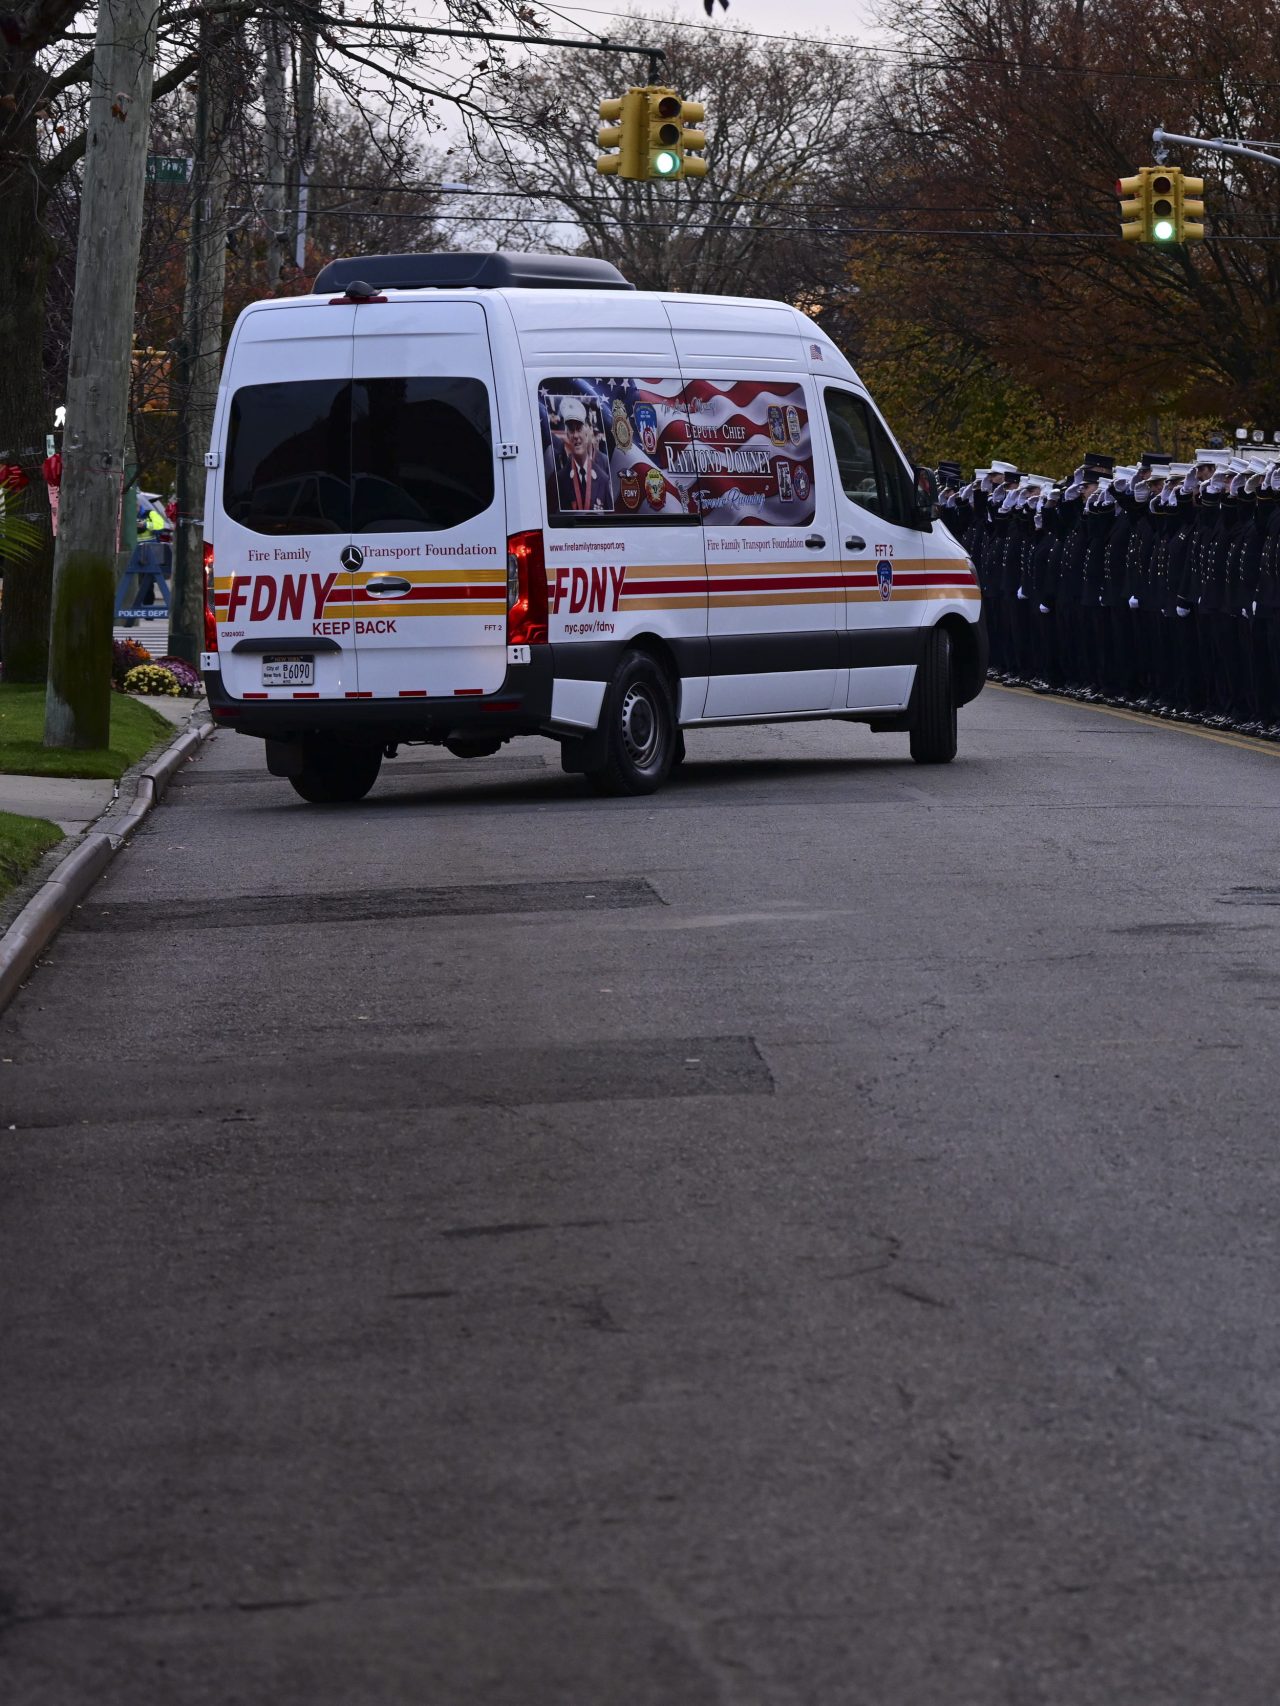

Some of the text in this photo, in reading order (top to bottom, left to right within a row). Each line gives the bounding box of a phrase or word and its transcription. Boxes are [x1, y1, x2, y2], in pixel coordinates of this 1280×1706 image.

[685, 424, 746, 439] DEPUTY CHIEF
[665, 446, 771, 473] RAYMOND DOWNEY
[624, 489, 637, 497] FDNY
[248, 543, 497, 562] Fire Family Transport Foundation
[550, 542, 625, 552] www.firefamilytransport.org
[707, 538, 804, 552] Fire Family Transport Foundation
[875, 544, 893, 556] FFT 2
[227, 572, 338, 622] FDNY
[553, 566, 627, 614] FDNY
[312, 620, 397, 635] KEEP BACK
[564, 620, 615, 633] nyc.gov/fdny
